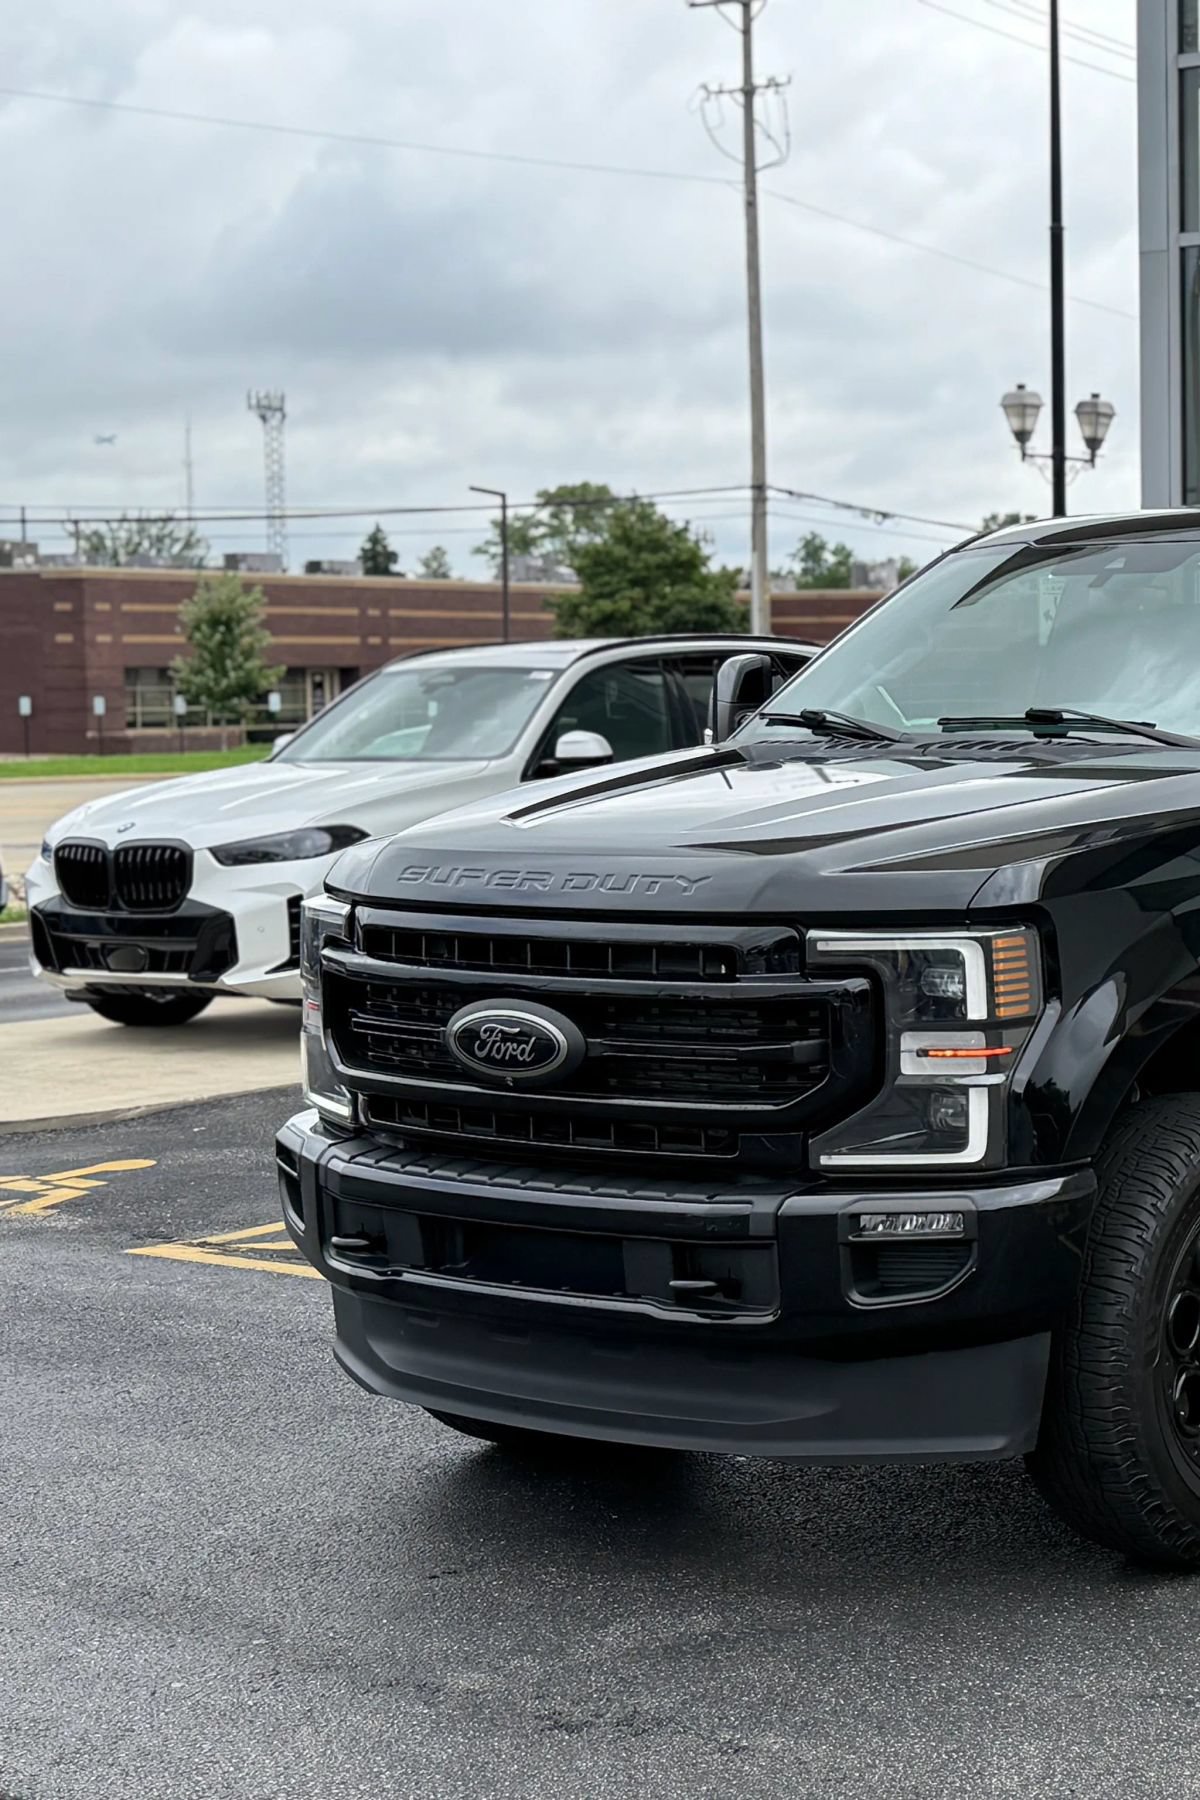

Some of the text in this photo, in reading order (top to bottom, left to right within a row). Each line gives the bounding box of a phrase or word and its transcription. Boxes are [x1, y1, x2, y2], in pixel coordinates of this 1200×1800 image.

[397, 865, 713, 896] SUPER DUTY
[474, 1023, 537, 1062] Ford
